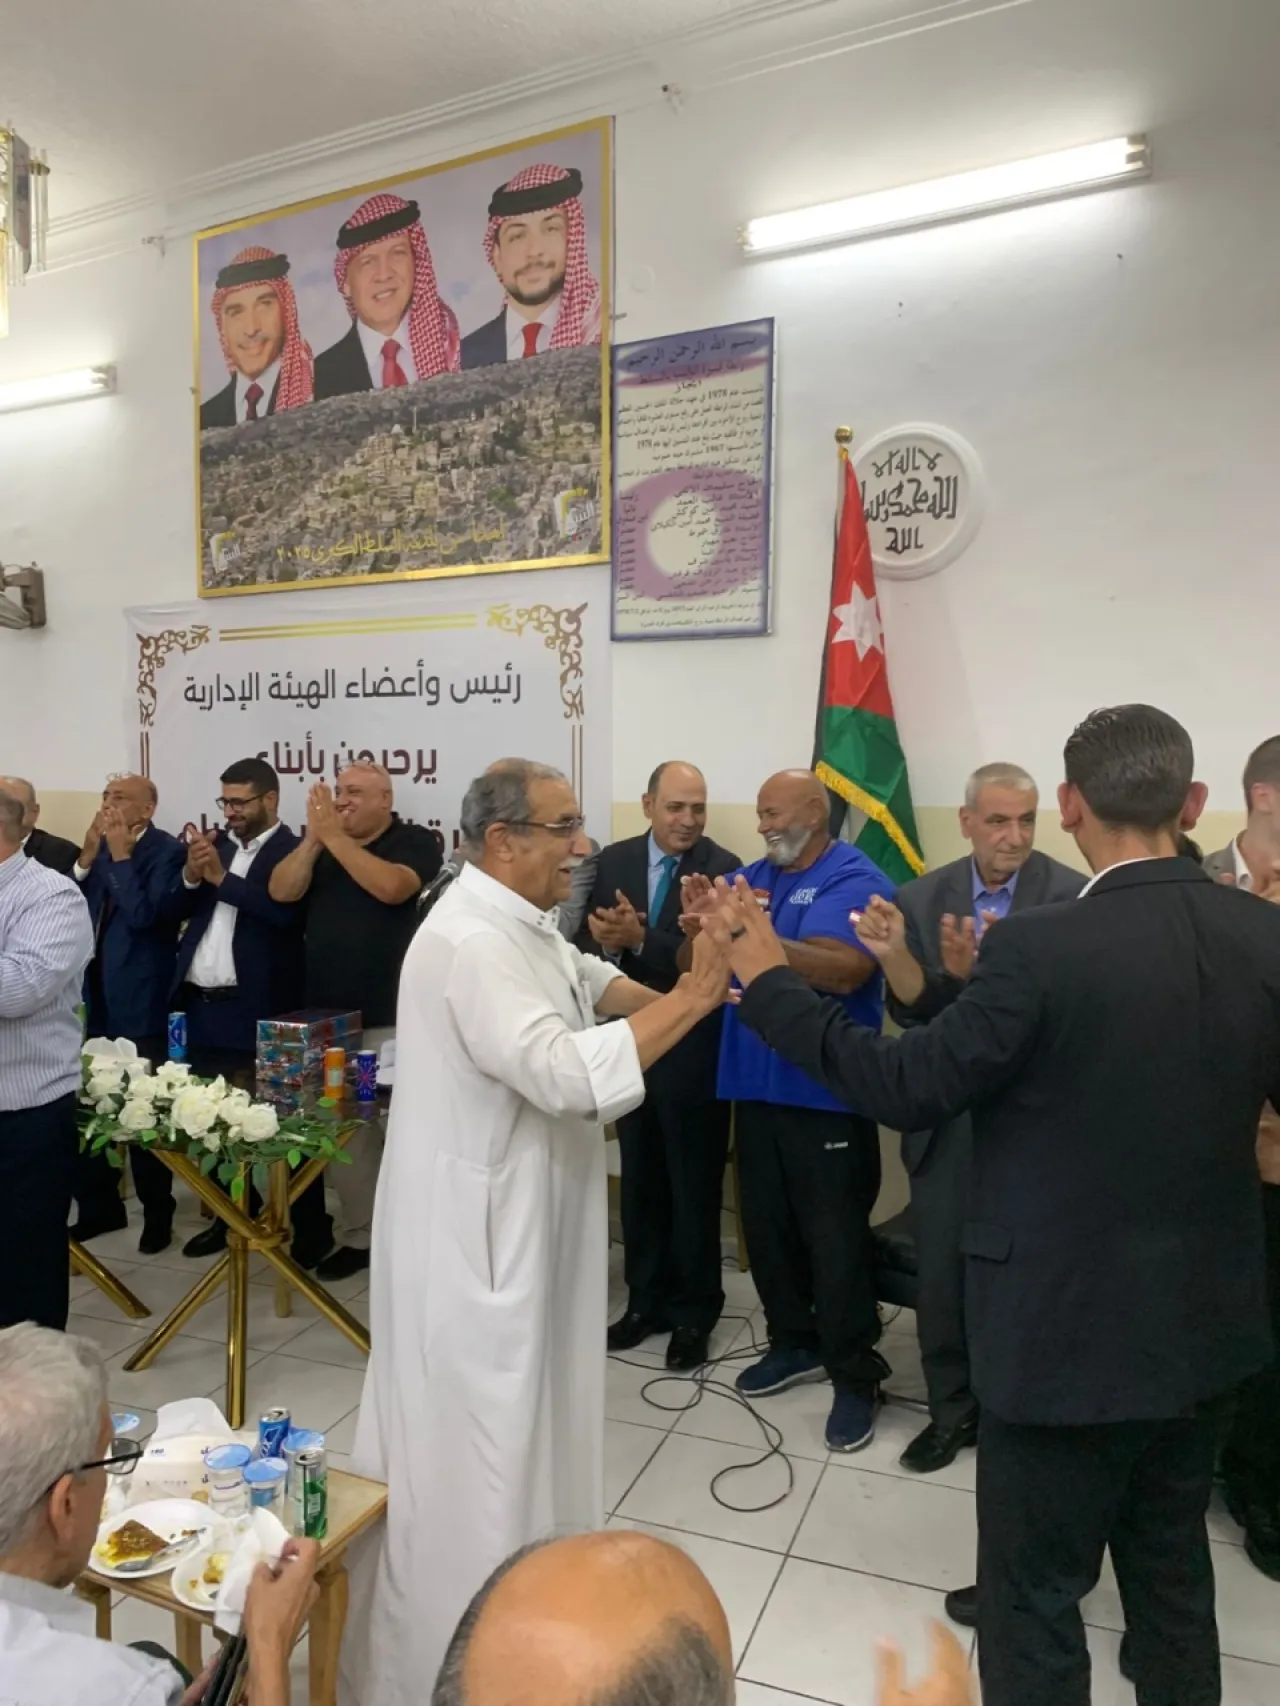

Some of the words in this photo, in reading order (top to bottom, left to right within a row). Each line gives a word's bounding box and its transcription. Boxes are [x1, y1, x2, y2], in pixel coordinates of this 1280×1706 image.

[710, 333, 727, 351] الله
[925, 475, 959, 520] الله
[885, 526, 924, 555] الله
[183, 671, 260, 711] الإدارية
[267, 667, 336, 710] الهيئة
[344, 658, 441, 706] وأعضاء
[449, 662, 521, 704] رئيس
[255, 730, 325, 783] بأبناء
